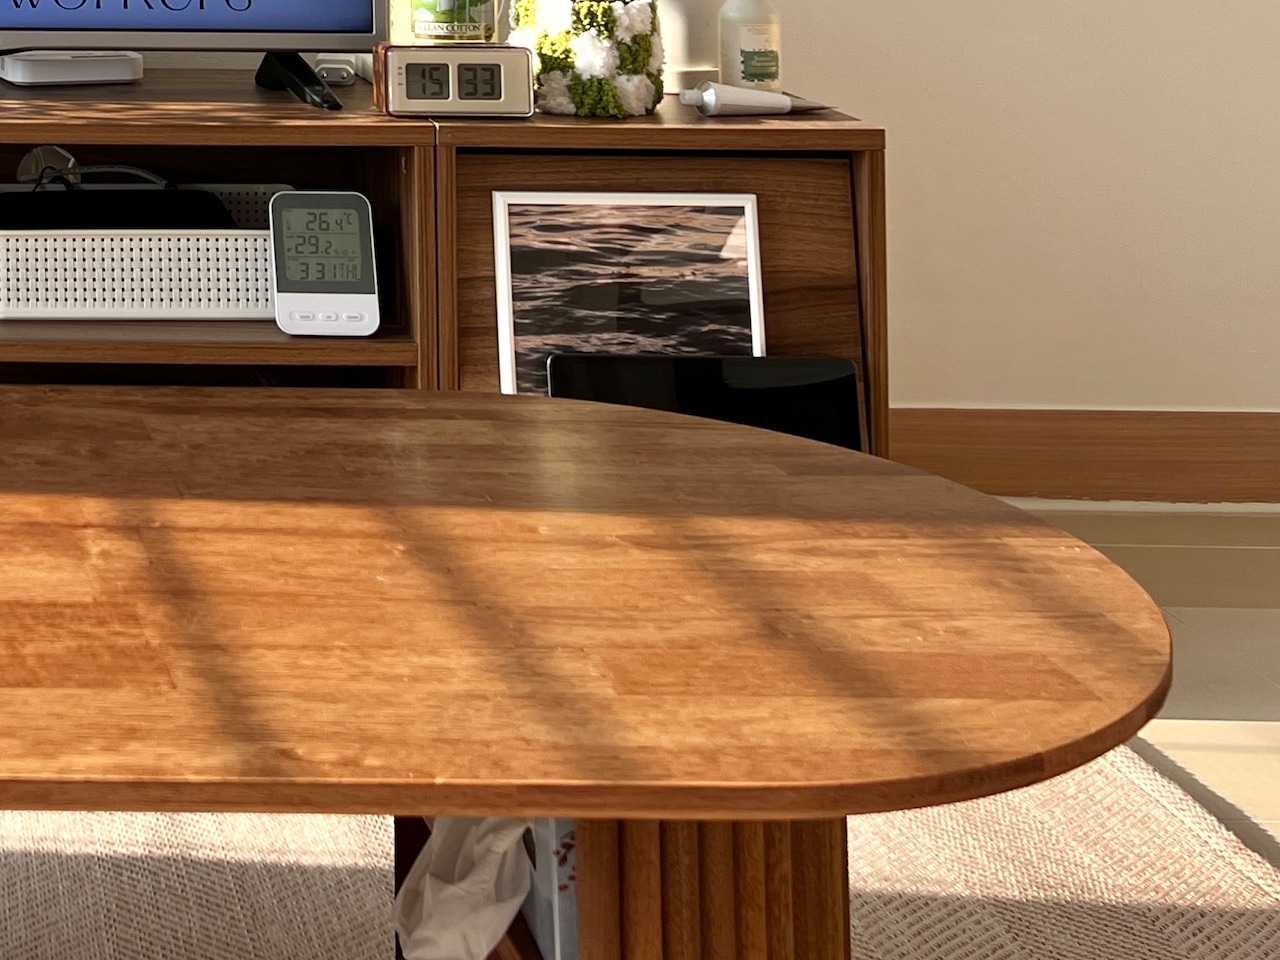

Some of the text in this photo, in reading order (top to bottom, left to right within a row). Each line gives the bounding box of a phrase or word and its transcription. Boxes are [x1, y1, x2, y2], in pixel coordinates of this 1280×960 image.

[417, 23, 482, 33] CLEAN COTTON
[421, 66, 496, 97] 15 33
